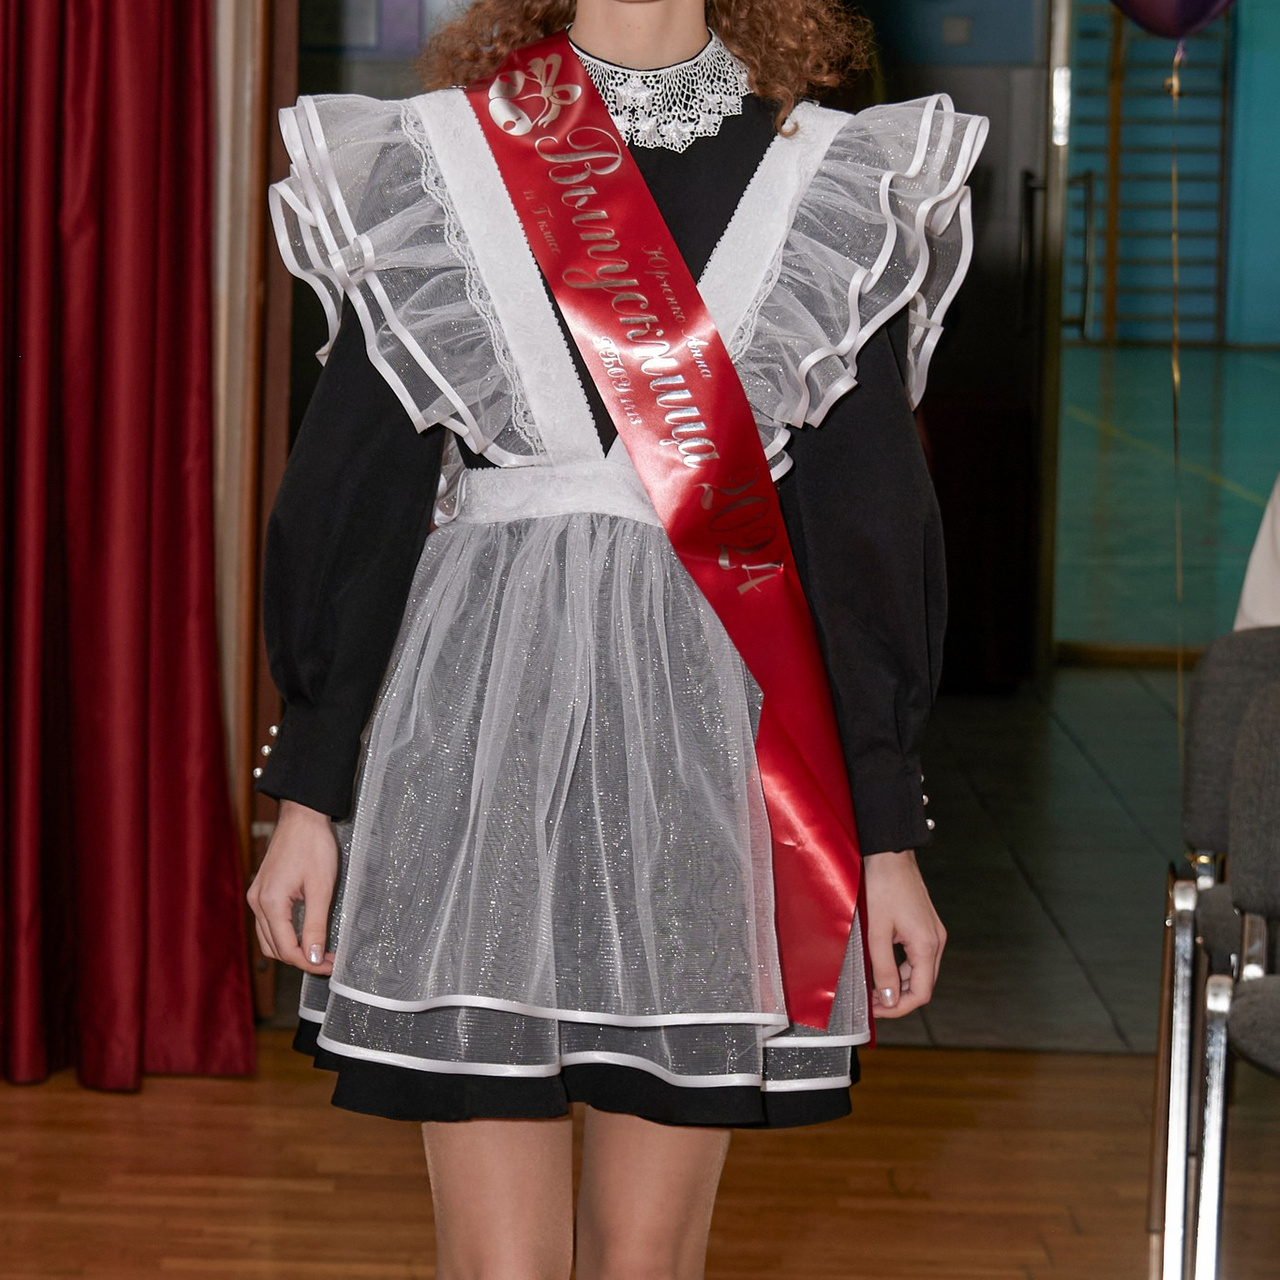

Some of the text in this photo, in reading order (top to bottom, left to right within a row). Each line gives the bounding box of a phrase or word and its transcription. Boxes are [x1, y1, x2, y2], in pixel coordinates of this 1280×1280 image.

[537, 220, 562, 255] класс
[534, 126, 784, 596] Выпускница 2024
[641, 244, 713, 379] Юрченко Анна
